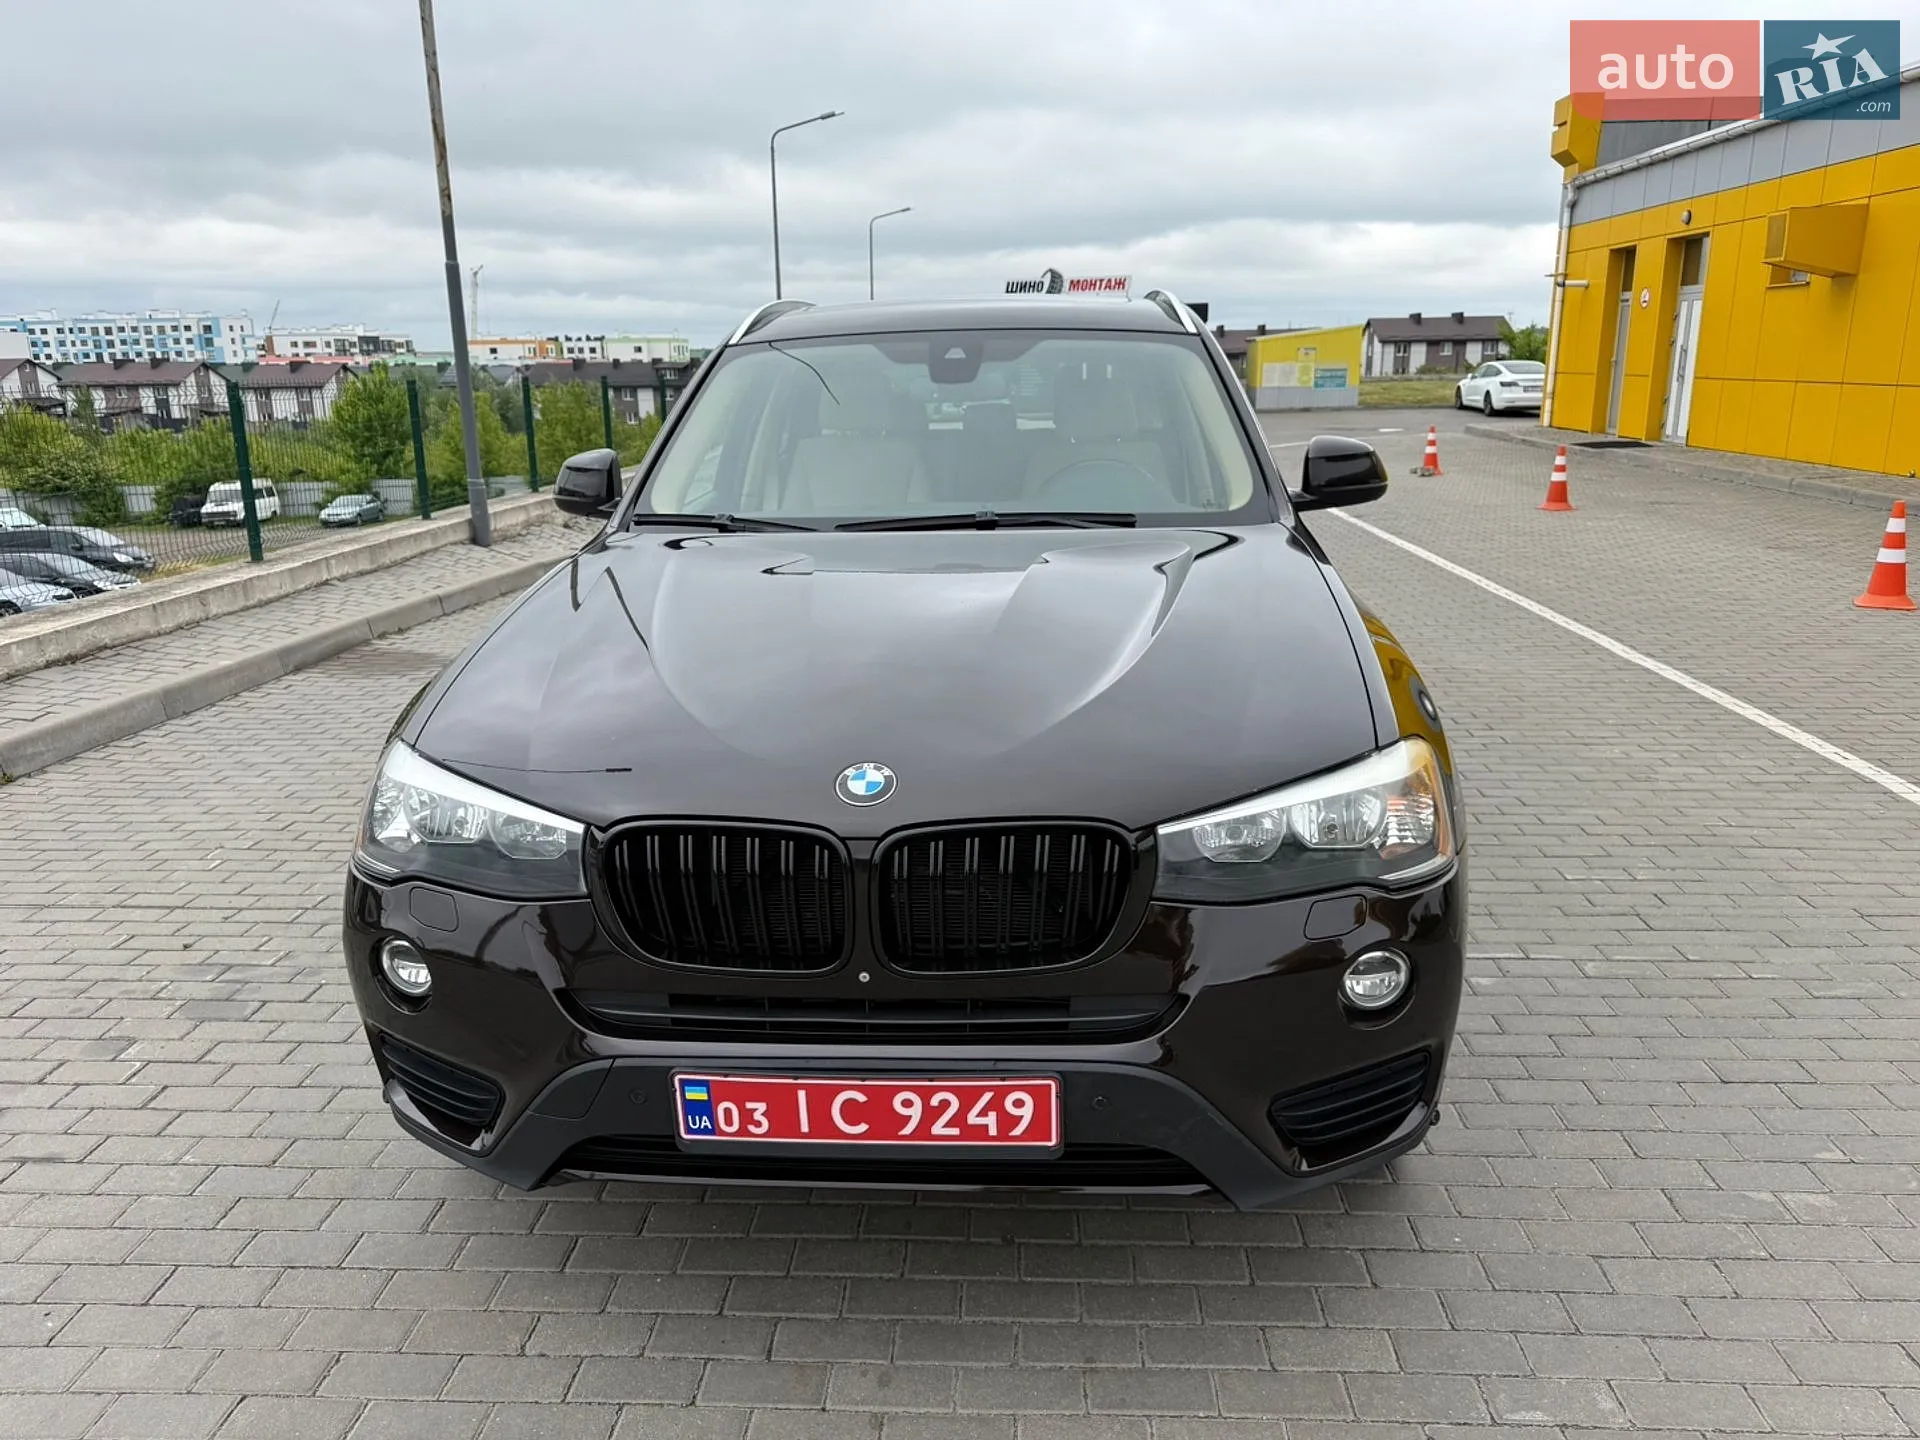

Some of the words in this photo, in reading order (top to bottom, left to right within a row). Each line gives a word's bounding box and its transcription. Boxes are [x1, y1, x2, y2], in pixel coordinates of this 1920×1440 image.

[1005, 279, 1044, 294] ШИНО
[1068, 277, 1127, 293] МОНТАЖ
[687, 1114, 712, 1130] UA
[717, 1101, 770, 1134] 03
[892, 1091, 1035, 1137] 9249
